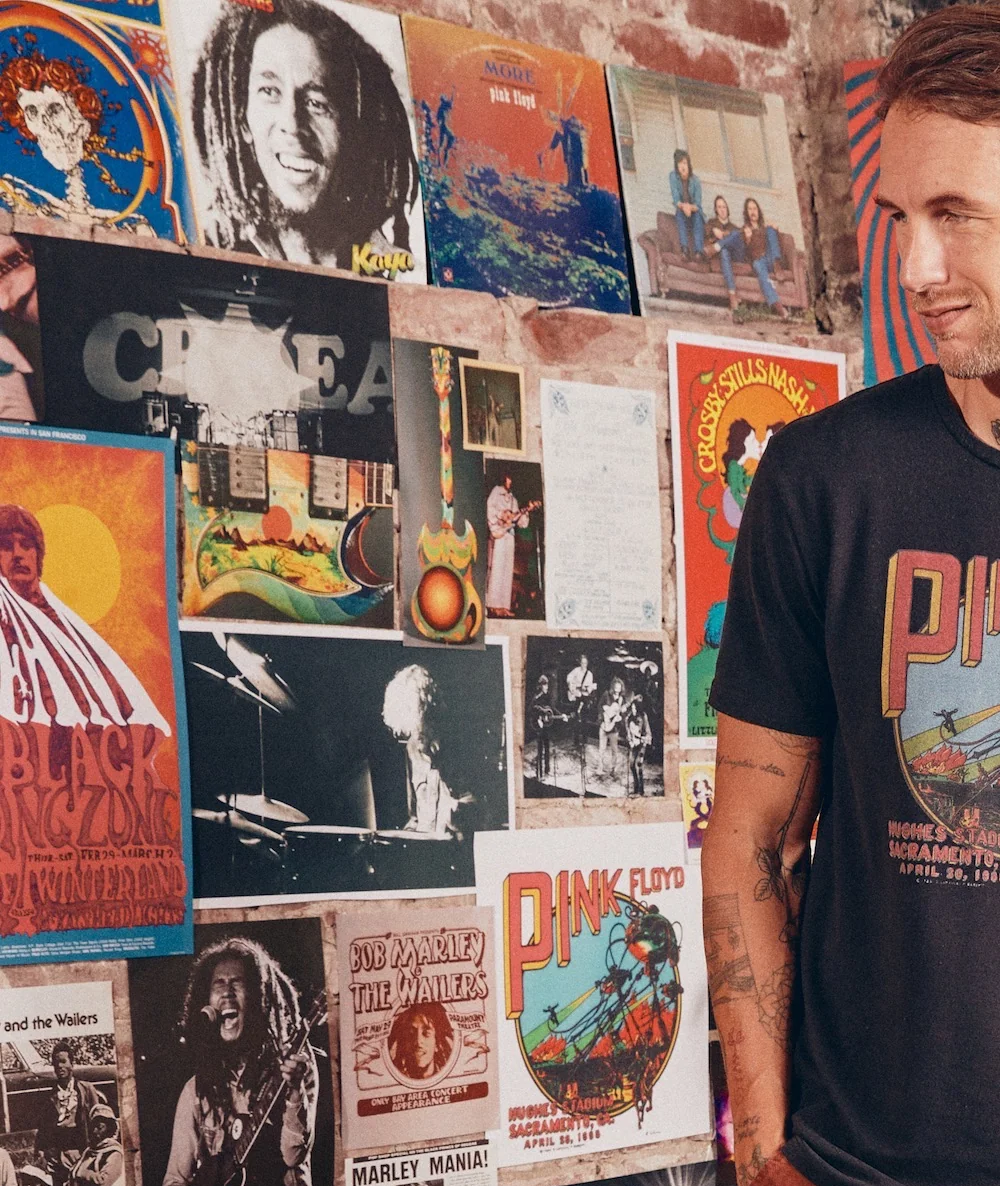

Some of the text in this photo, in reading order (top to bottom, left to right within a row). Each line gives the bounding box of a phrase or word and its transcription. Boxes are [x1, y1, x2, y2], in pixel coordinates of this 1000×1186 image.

[484, 60, 536, 84] MORE
[352, 242, 415, 281] Kaya
[887, 820, 947, 842] HUGHES
[900, 862, 940, 878] APRIL
[349, 932, 486, 974] BOB MARLEY
[503, 866, 685, 1020] PINK FLOYD
[348, 970, 489, 1014] THE WAILERS
[4, 1012, 98, 1032] and the Wailers
[371, 1085, 469, 1107] ONLY BAY AREA CONCERT
[392, 1095, 451, 1112] APPEARANCE
[508, 1094, 615, 1123] HUGHES STADIUM
[523, 1137, 555, 1150] APRIL
[352, 1150, 488, 1186] MARLEY MANIA!
